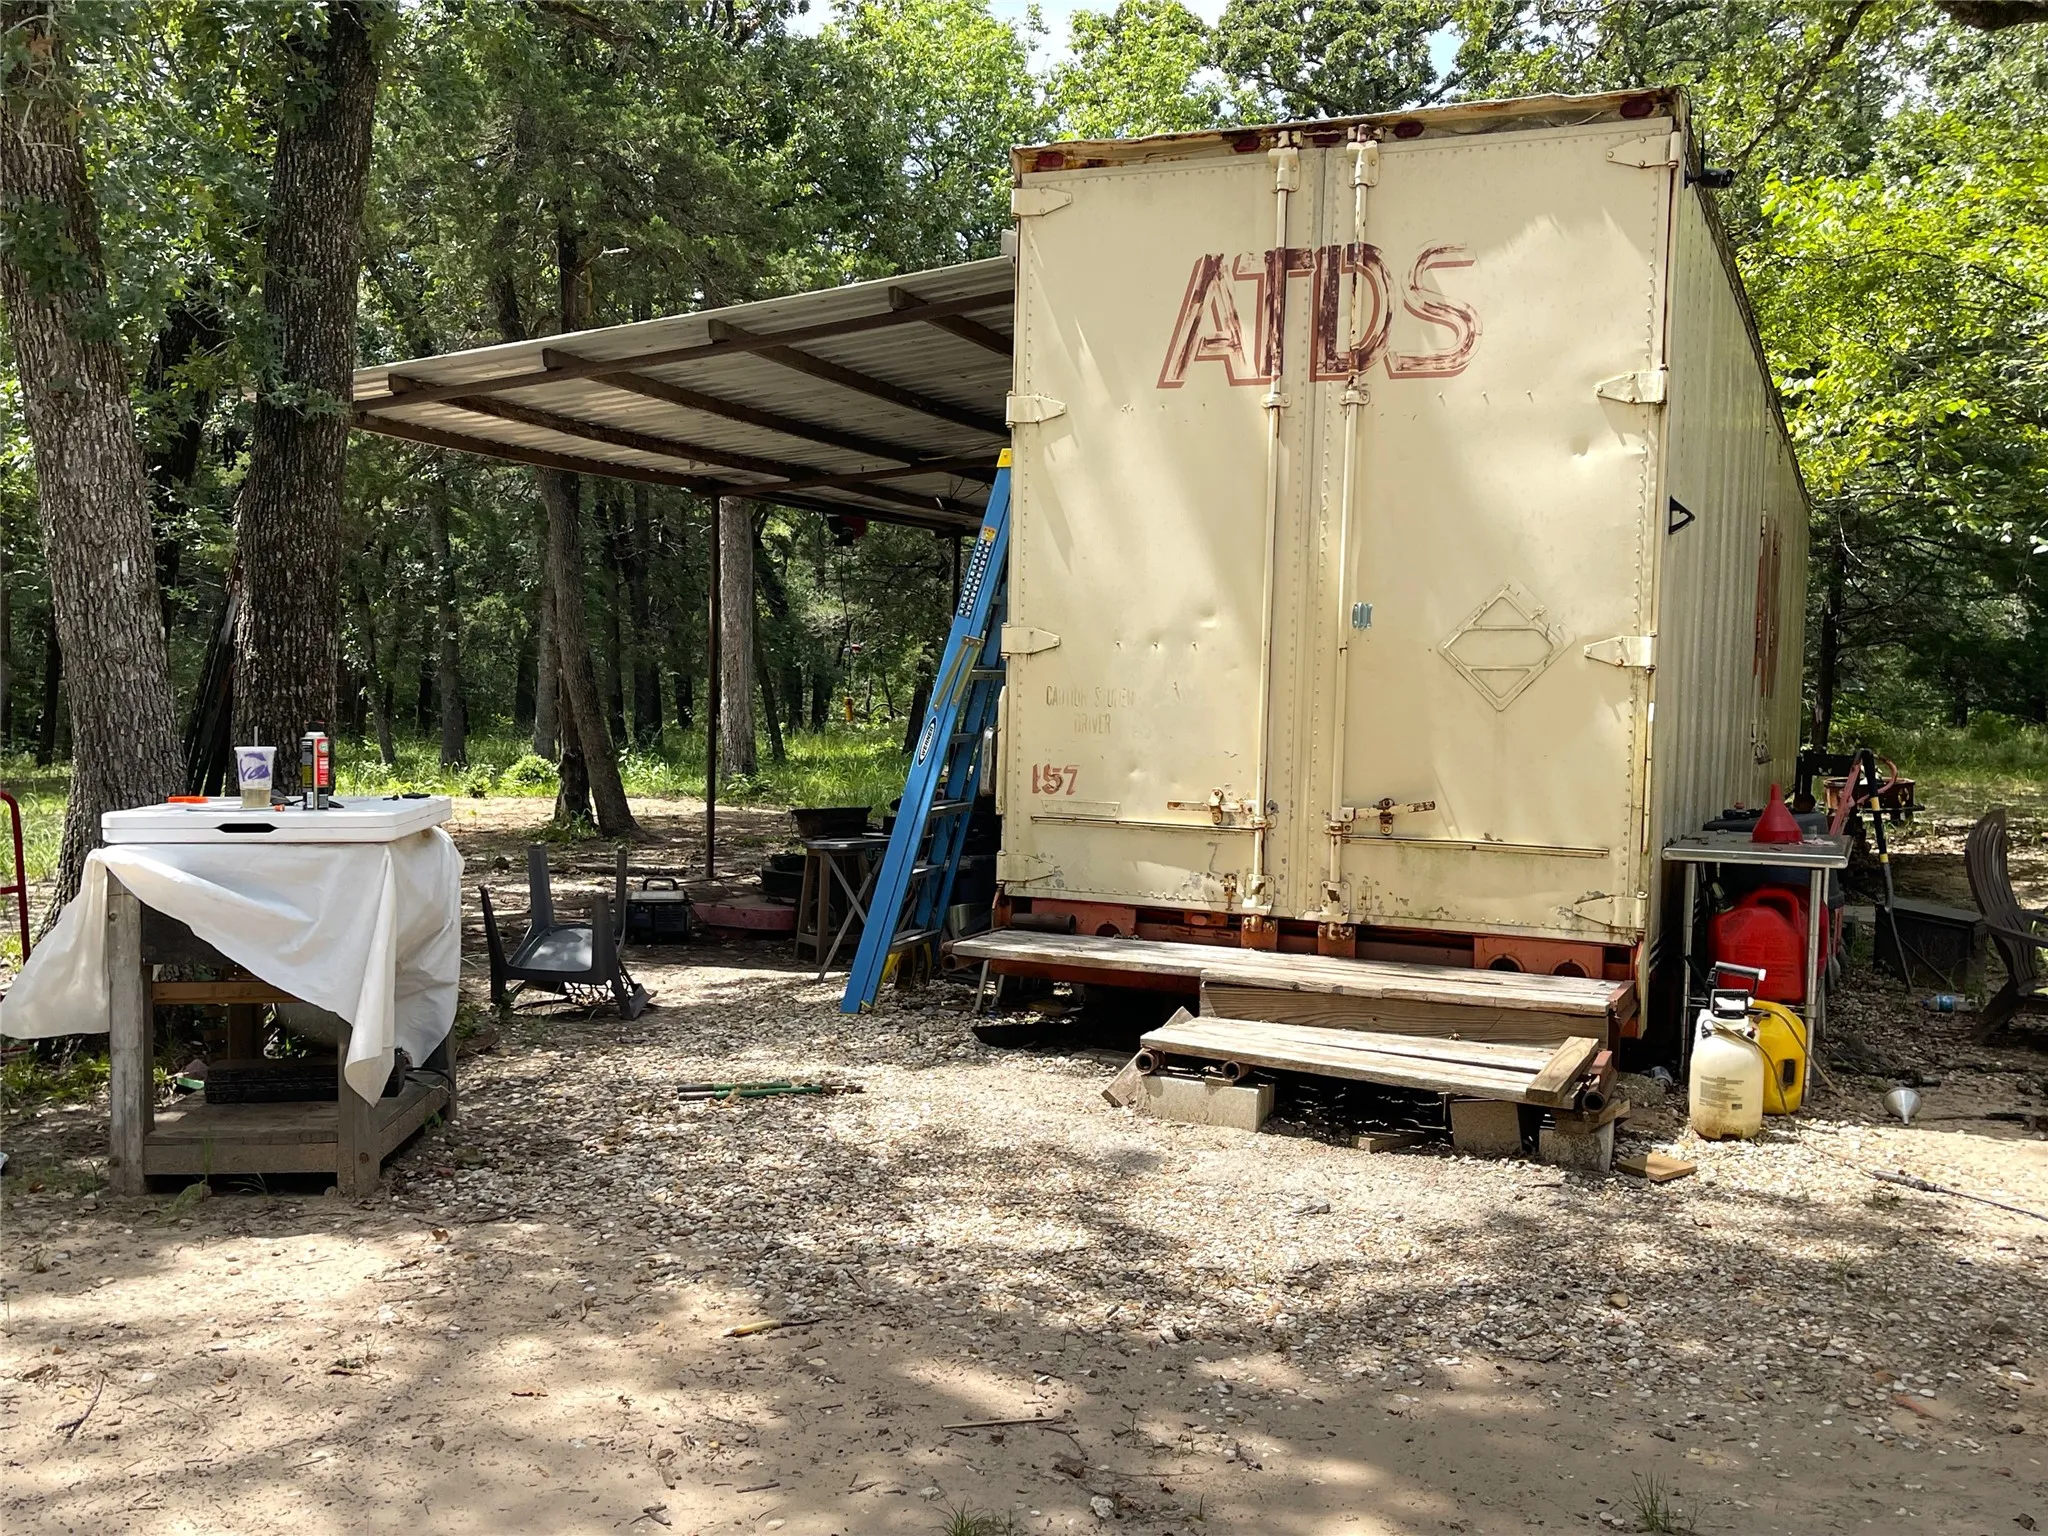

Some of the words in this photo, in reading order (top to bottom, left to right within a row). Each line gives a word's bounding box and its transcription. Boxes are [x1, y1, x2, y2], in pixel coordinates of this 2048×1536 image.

[1157, 243, 1482, 388] ATDS
[1074, 713, 1111, 734] DRIVER
[921, 726, 934, 756] WERNER
[1032, 763, 1080, 796] 157
